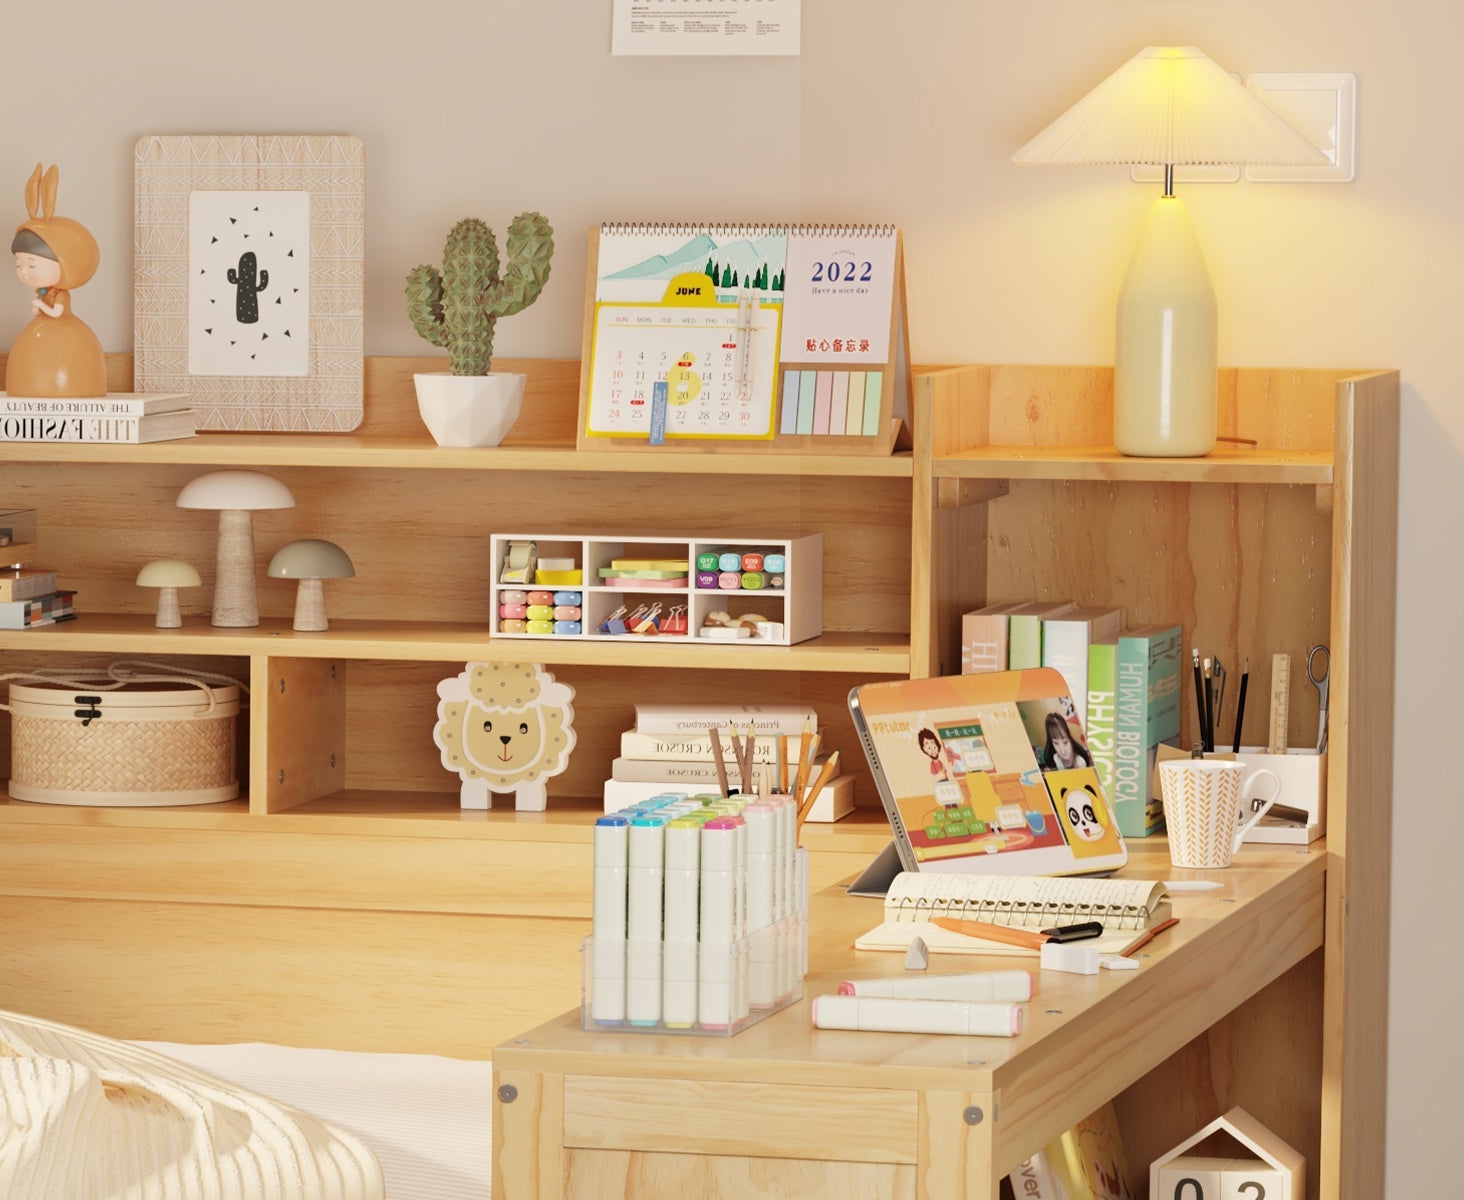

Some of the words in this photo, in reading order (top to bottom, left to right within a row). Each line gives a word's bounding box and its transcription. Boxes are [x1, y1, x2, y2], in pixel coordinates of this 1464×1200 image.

[811, 261, 872, 282] 2022
[675, 287, 701, 296] JUNE
[856, 287, 869, 295] day
[805, 338, 870, 353] 贴心备忘录
[616, 351, 622, 360] 3
[638, 351, 644, 361] 4
[661, 352, 667, 361] 5
[682, 352, 689, 361] 6
[705, 352, 712, 362] 7
[725, 353, 732, 362] 8
[612, 370, 624, 380] 10
[636, 371, 645, 380] 11
[657, 371, 668, 381] 12
[680, 371, 690, 381] 13
[702, 372, 712, 381] 14
[722, 372, 733, 382] 15
[610, 390, 622, 399] 17
[633, 390, 645, 399] 18
[676, 391, 689, 400] 20
[699, 391, 711, 400] 21
[720, 392, 731, 401] 22
[5, 401, 47, 411] BEAUTY
[49, 402, 64, 412] OF
[66, 402, 106, 413] ALLURE
[109, 402, 130, 413] THE
[608, 409, 620, 418] 24
[631, 409, 643, 419] 25
[675, 410, 687, 420] 27
[698, 411, 710, 420] 28
[718, 411, 730, 420] 29
[738, 411, 750, 421] 30
